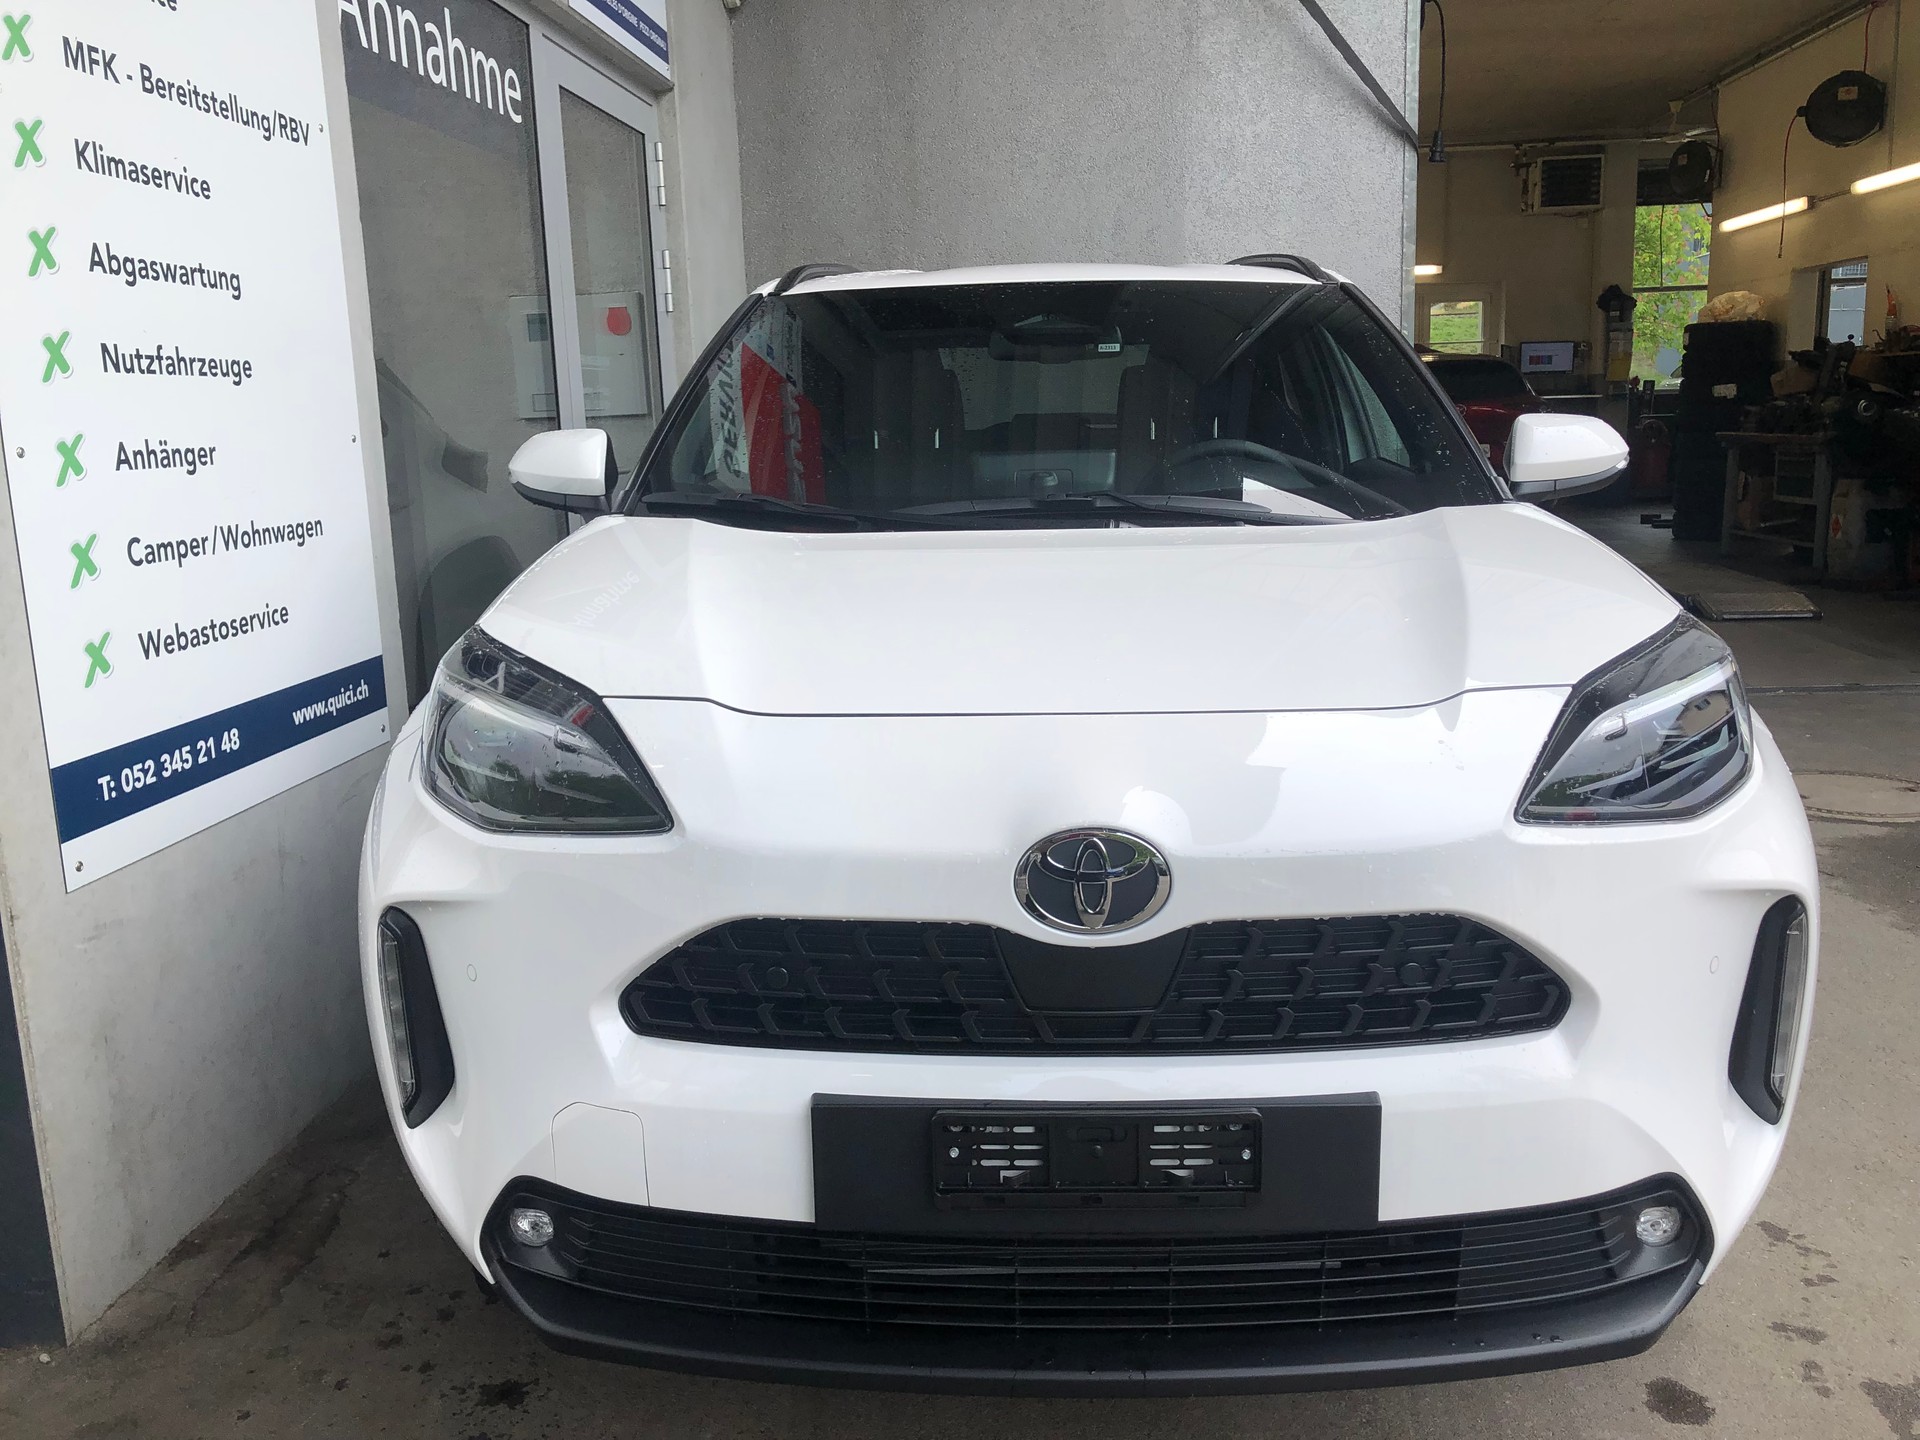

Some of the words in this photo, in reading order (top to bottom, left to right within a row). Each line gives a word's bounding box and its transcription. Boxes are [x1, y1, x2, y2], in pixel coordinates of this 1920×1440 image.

[62, 36, 121, 84] MFK
[139, 62, 310, 146] Bereitstellung/RBV
[74, 138, 211, 200] Klimaservice
[89, 242, 242, 300] Abgaswartung
[100, 342, 253, 386] Nutzfahrzeuge
[115, 439, 216, 476] Anhänger
[138, 603, 290, 660] Webastoservice
[292, 679, 369, 726] www.quici.ch
[97, 775, 117, 801] T:
[121, 759, 156, 793] 052
[160, 745, 193, 779] 345
[196, 736, 216, 764] 21
[221, 728, 240, 753] 48
